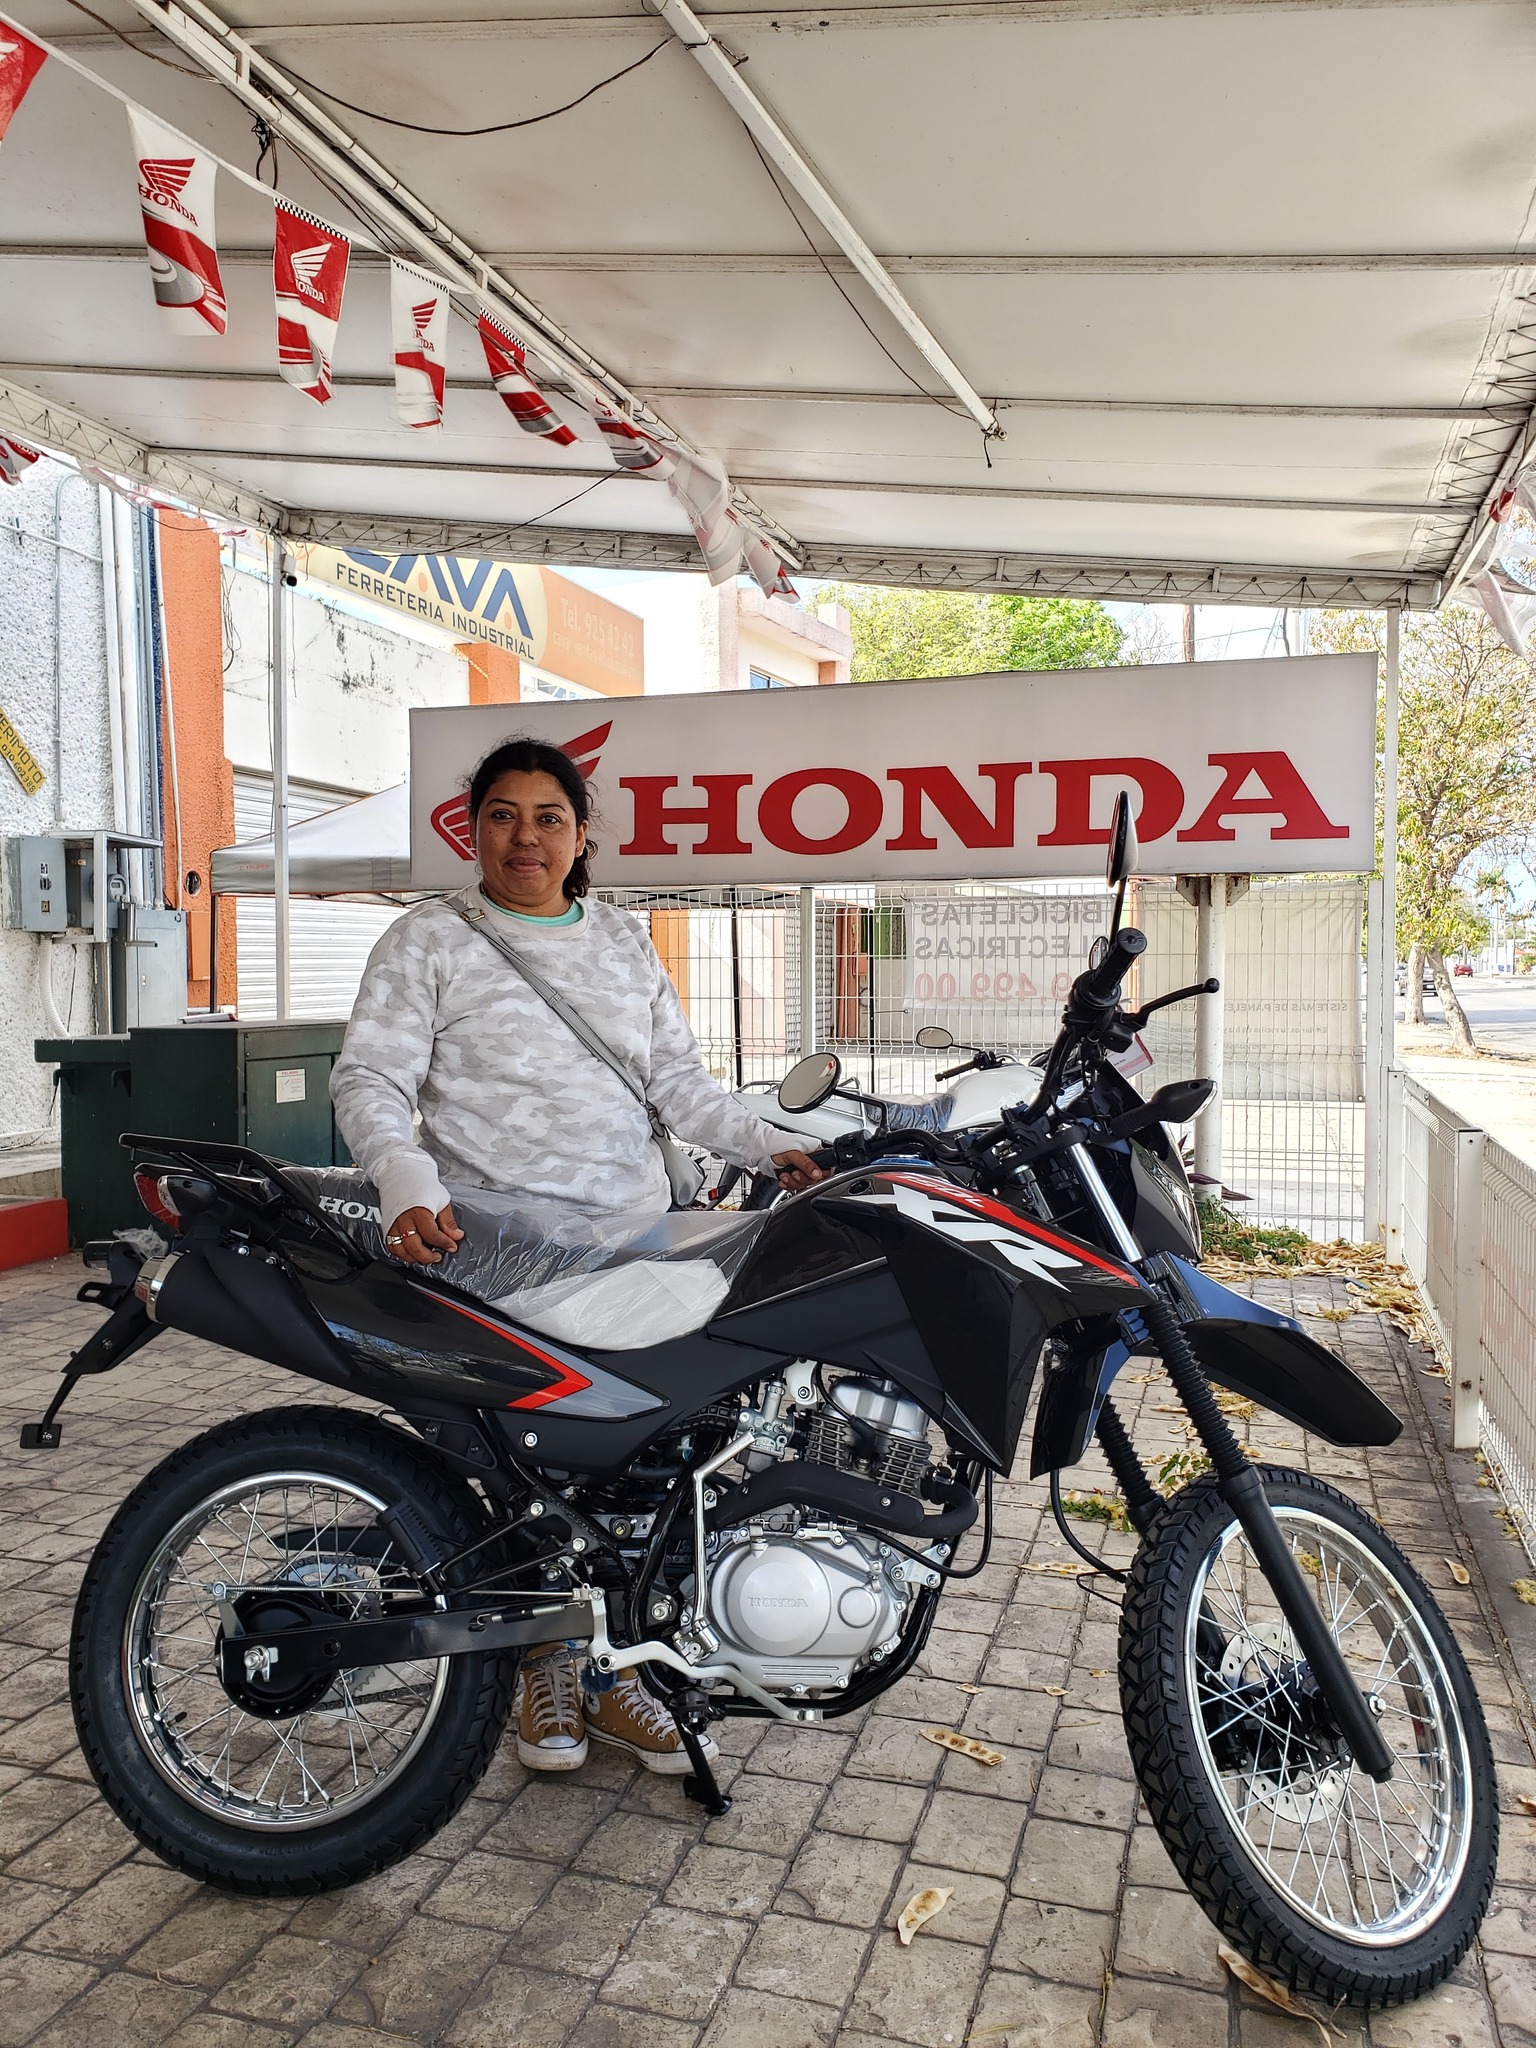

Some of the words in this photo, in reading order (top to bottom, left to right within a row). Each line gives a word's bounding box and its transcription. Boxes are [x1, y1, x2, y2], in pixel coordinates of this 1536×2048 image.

[137, 182, 199, 227] HONDA
[336, 562, 445, 622] FERRETERIA
[452, 611, 535, 660] INDUSTRIAL
[561, 598, 581, 633] Tel.
[619, 751, 1349, 856] HONDA
[318, 1195, 382, 1224] HON
[748, 1596, 809, 1608] HONDA
